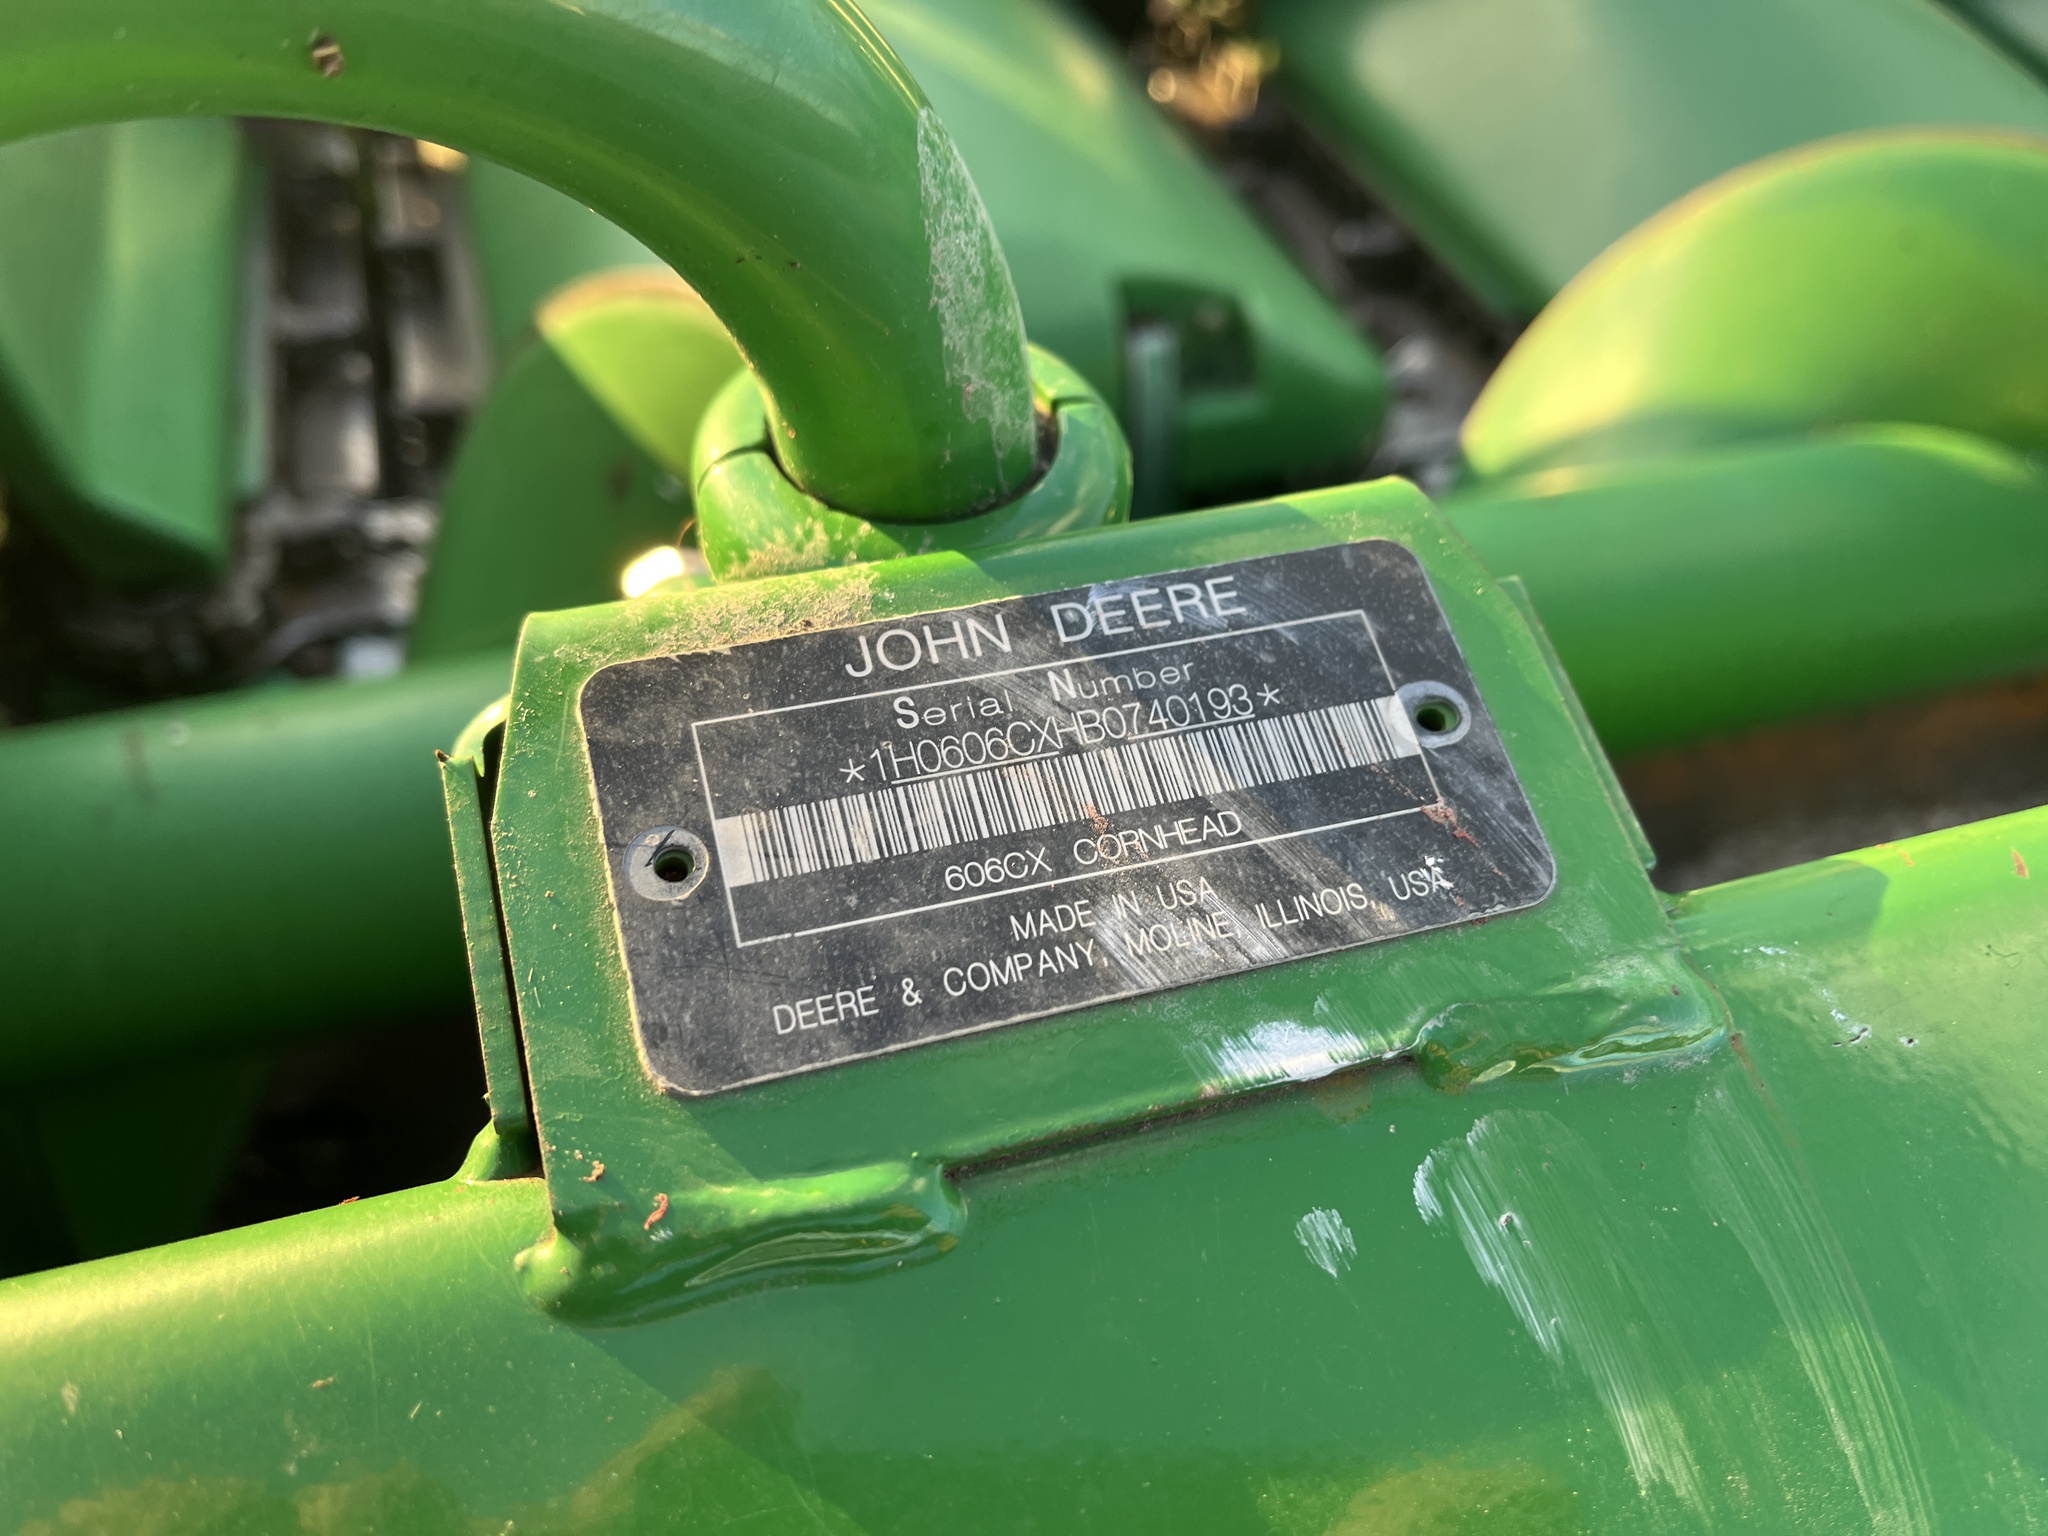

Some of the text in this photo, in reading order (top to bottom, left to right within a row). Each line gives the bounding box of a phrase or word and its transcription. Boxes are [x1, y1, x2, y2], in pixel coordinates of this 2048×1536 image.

[845, 575, 1246, 678] JOHN DEERE
[892, 662, 1195, 730] Serial Number
[944, 810, 1243, 892] 606CX CORNHEAD
[1010, 875, 1215, 941] MADE IN USA
[772, 867, 1454, 1036] DEERE & COMPANY, MOLINE, ILLINOIS, USA
